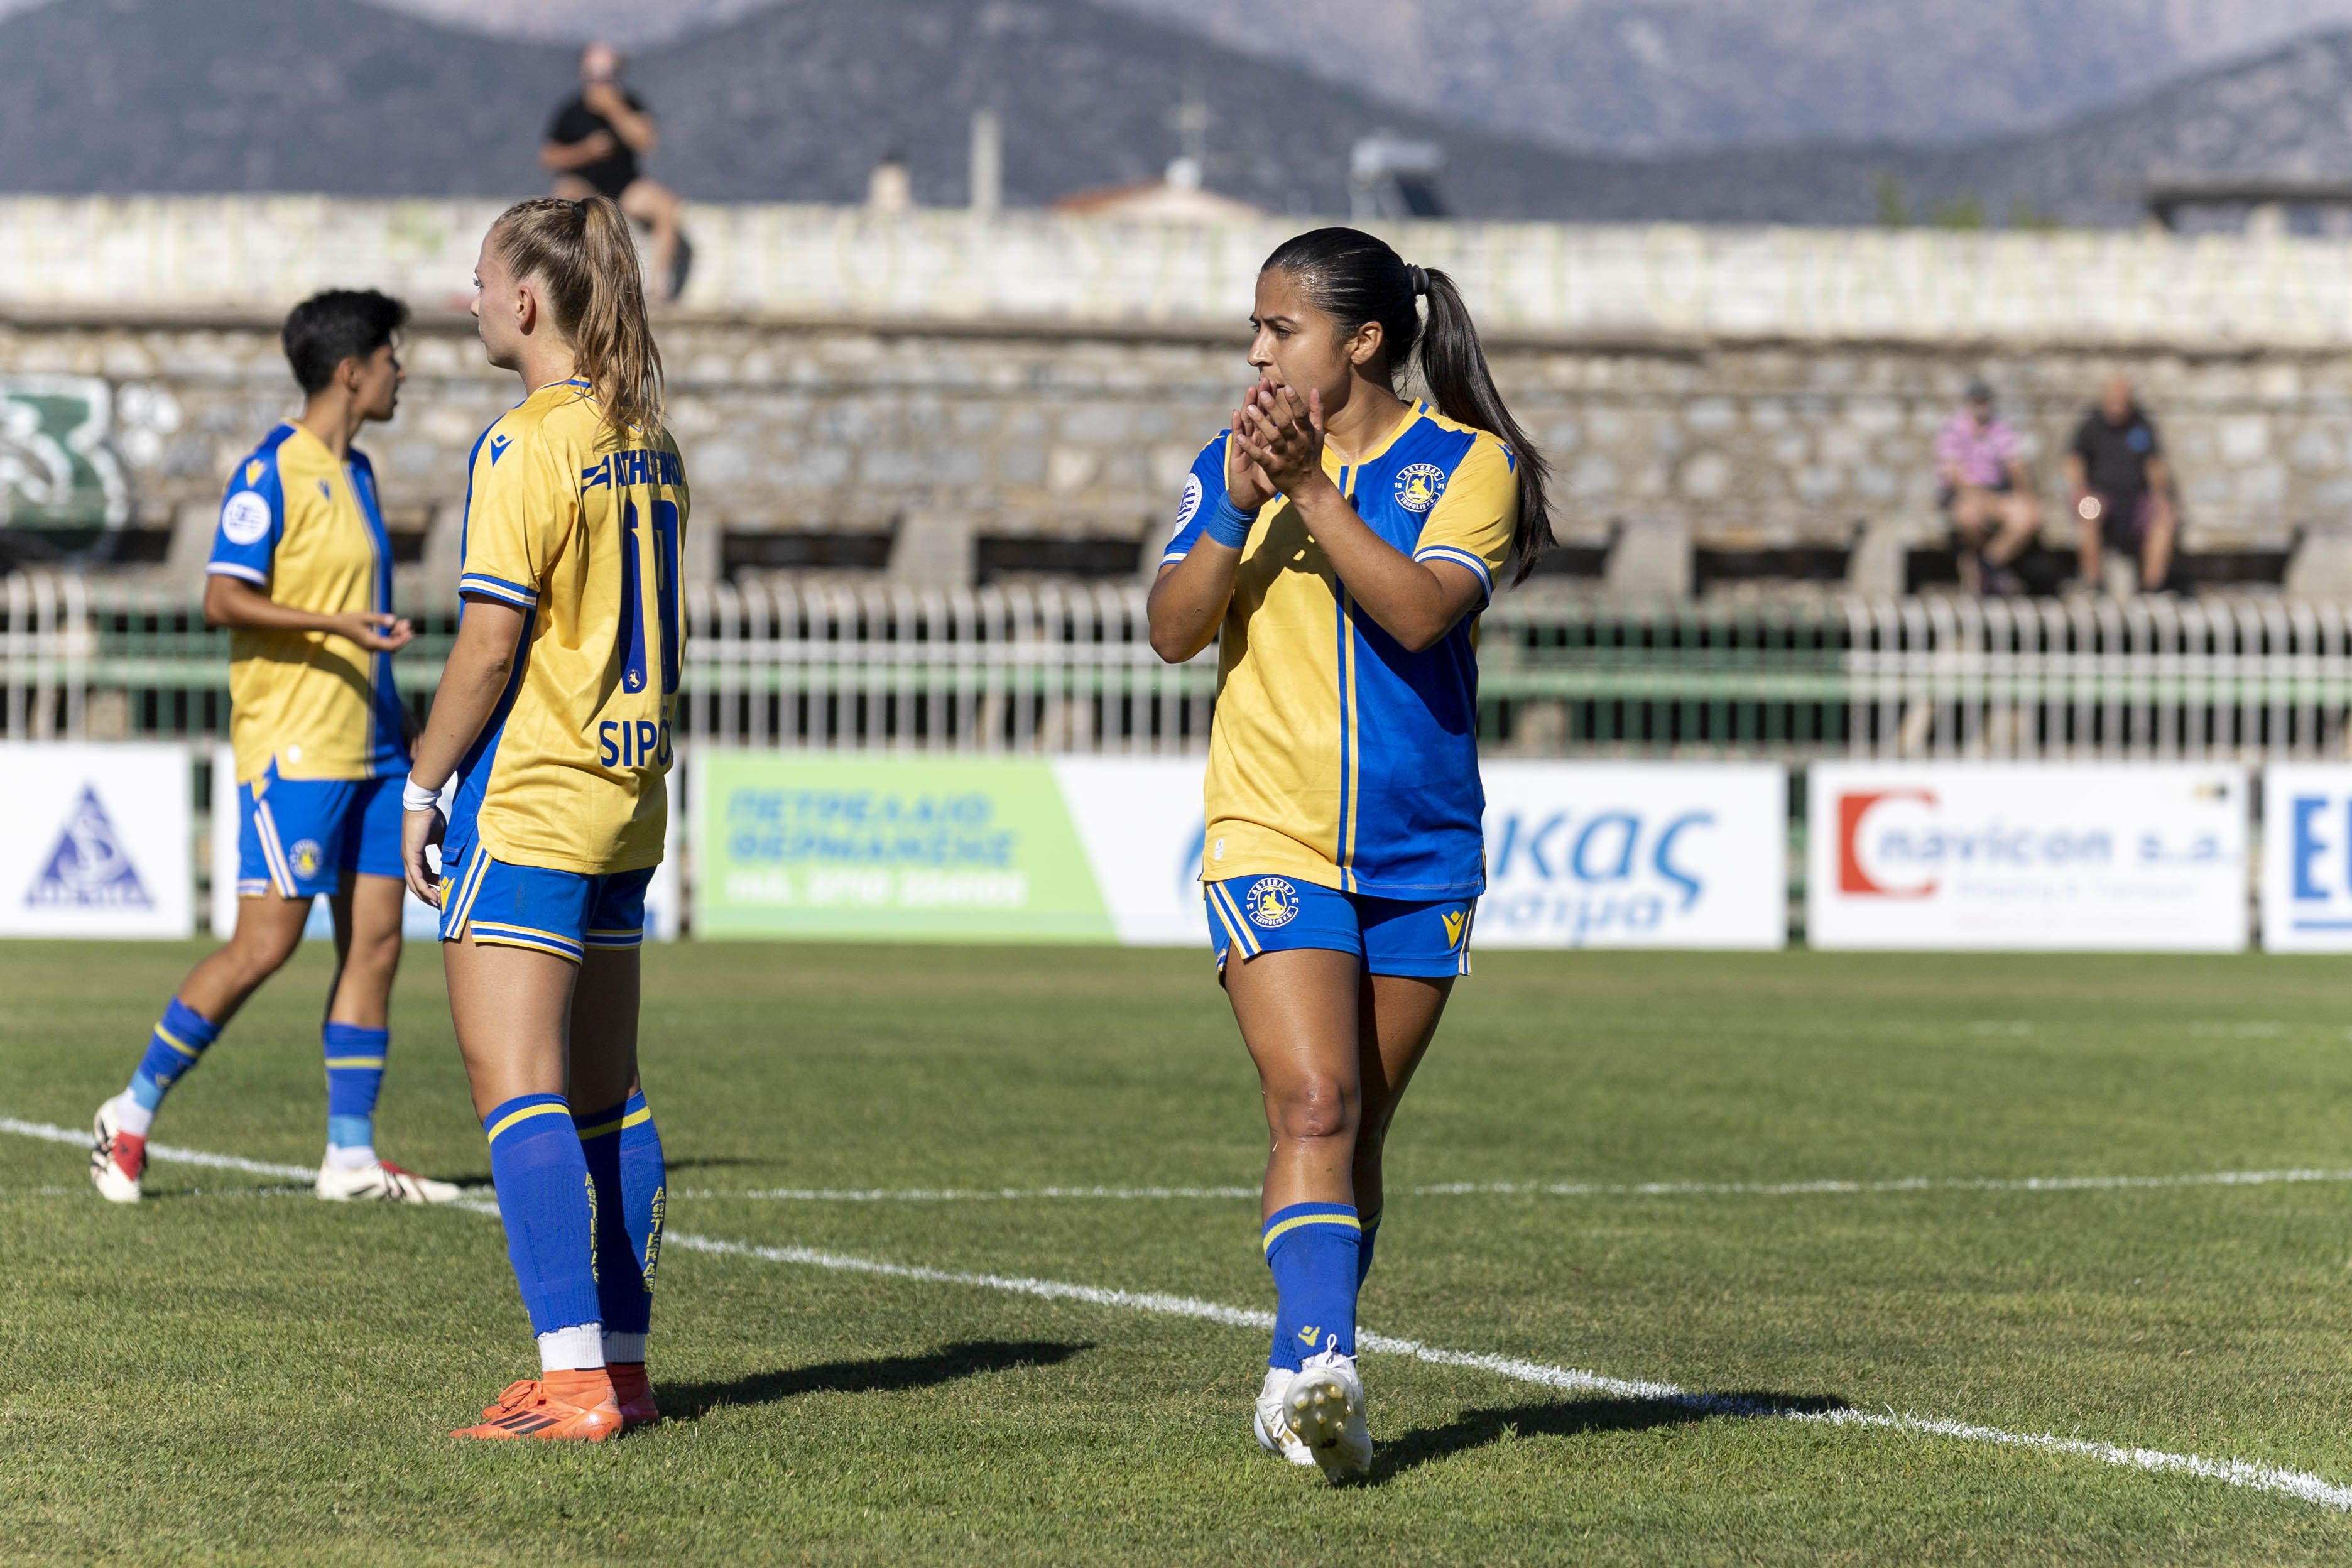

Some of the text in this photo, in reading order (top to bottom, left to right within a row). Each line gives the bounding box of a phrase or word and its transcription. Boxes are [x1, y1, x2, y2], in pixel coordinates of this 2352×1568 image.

[1403, 464, 1440, 477] ASTERAS
[1400, 496, 1426, 509] TRIPOLIS
[1876, 815, 2115, 867] navicon
[1491, 808, 1721, 912] κας
[1251, 879, 1290, 895] ASTERAS
[1255, 915, 1283, 925] TRIPOLIS
